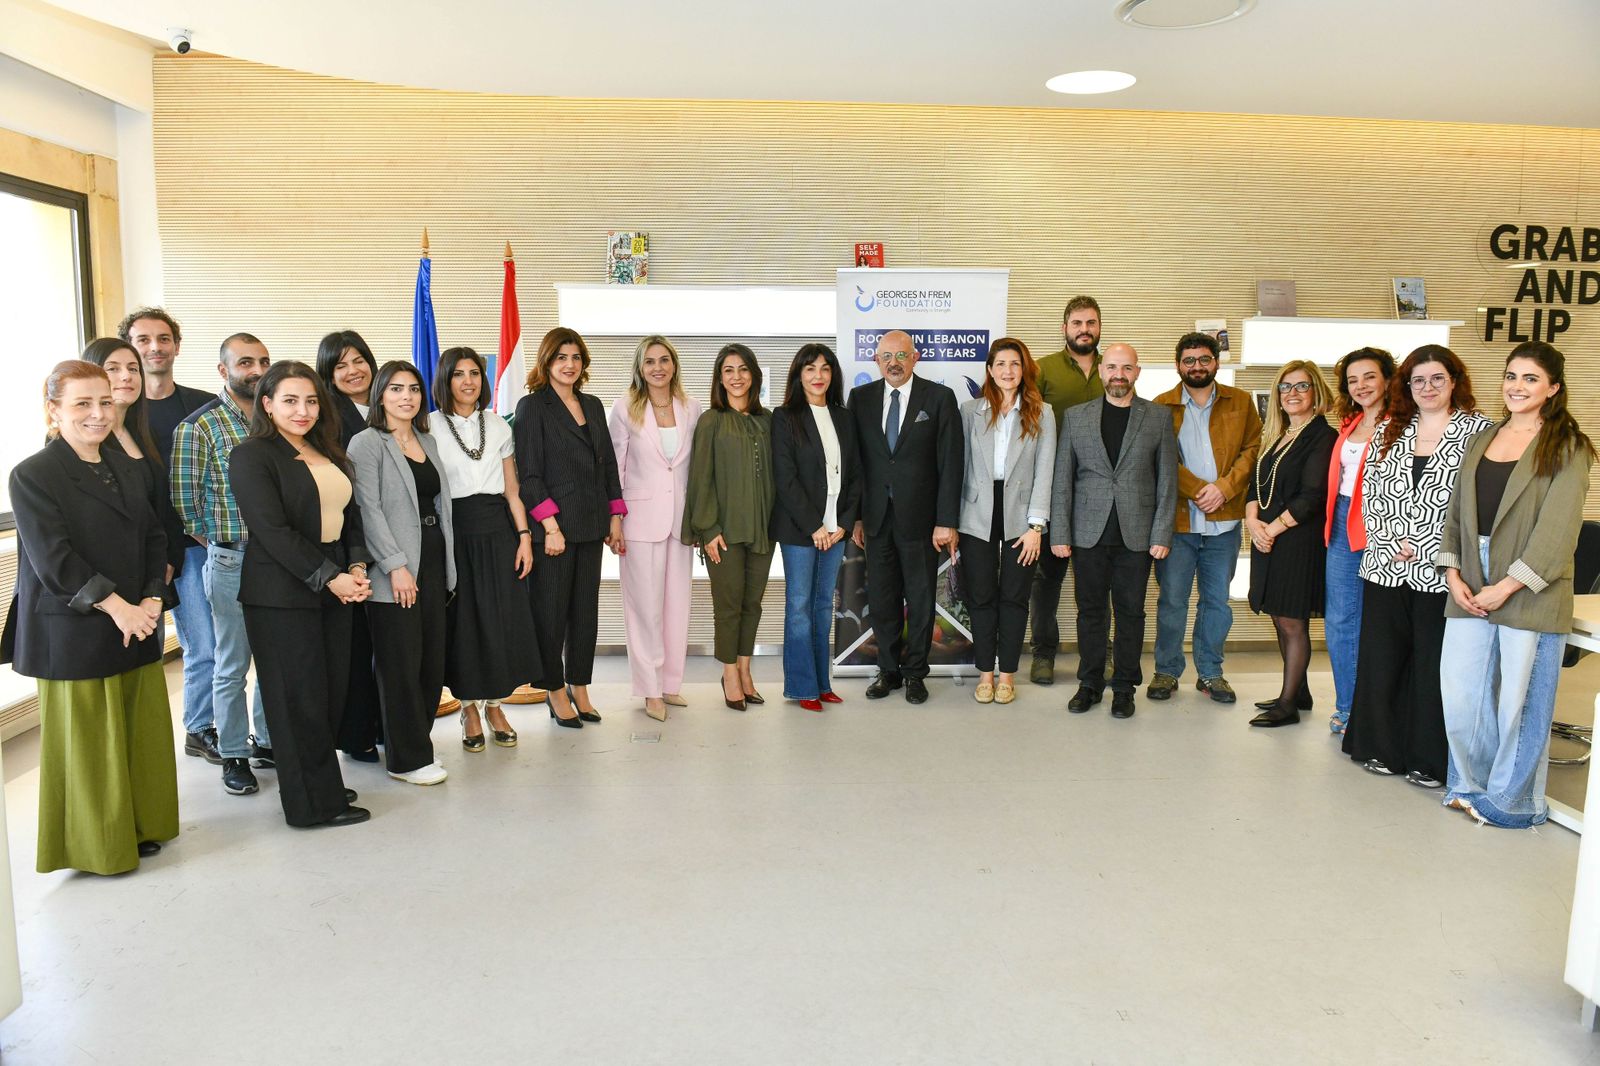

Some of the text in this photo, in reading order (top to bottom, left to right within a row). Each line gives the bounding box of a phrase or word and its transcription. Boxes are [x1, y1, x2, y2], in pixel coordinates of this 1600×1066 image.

[1490, 223, 1600, 262] GRAB
[1514, 268, 1600, 304] AND
[876, 290, 918, 299] GEORGES
[928, 290, 952, 299] FREM
[876, 299, 951, 308] FOUNDATION
[1485, 307, 1571, 343] FLIP
[911, 334, 924, 344] IN
[928, 334, 986, 344] LEBANON
[921, 348, 935, 358] 25
[938, 348, 976, 358] YEARS
